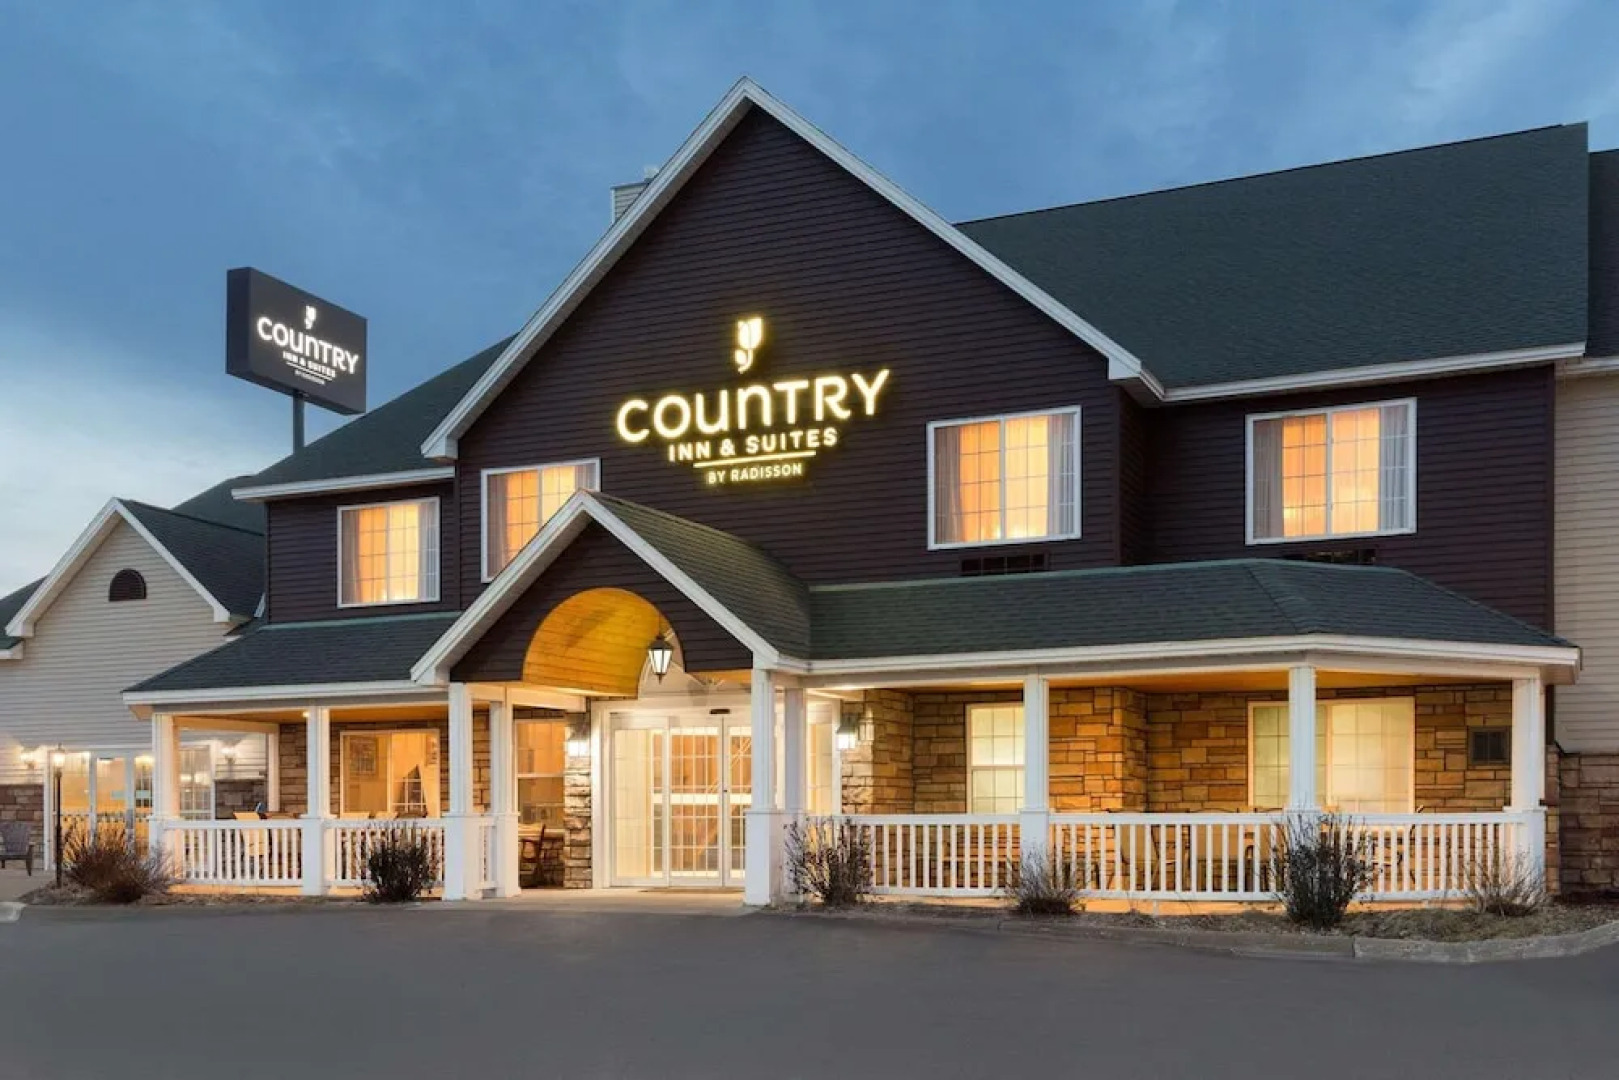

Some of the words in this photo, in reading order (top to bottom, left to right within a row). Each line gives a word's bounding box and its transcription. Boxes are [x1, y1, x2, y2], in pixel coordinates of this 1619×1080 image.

[668, 441, 711, 462] INN
[719, 438, 736, 457] &
[745, 427, 838, 454] SUITES
[706, 470, 726, 484] BY
[731, 463, 802, 482] RADISSON
